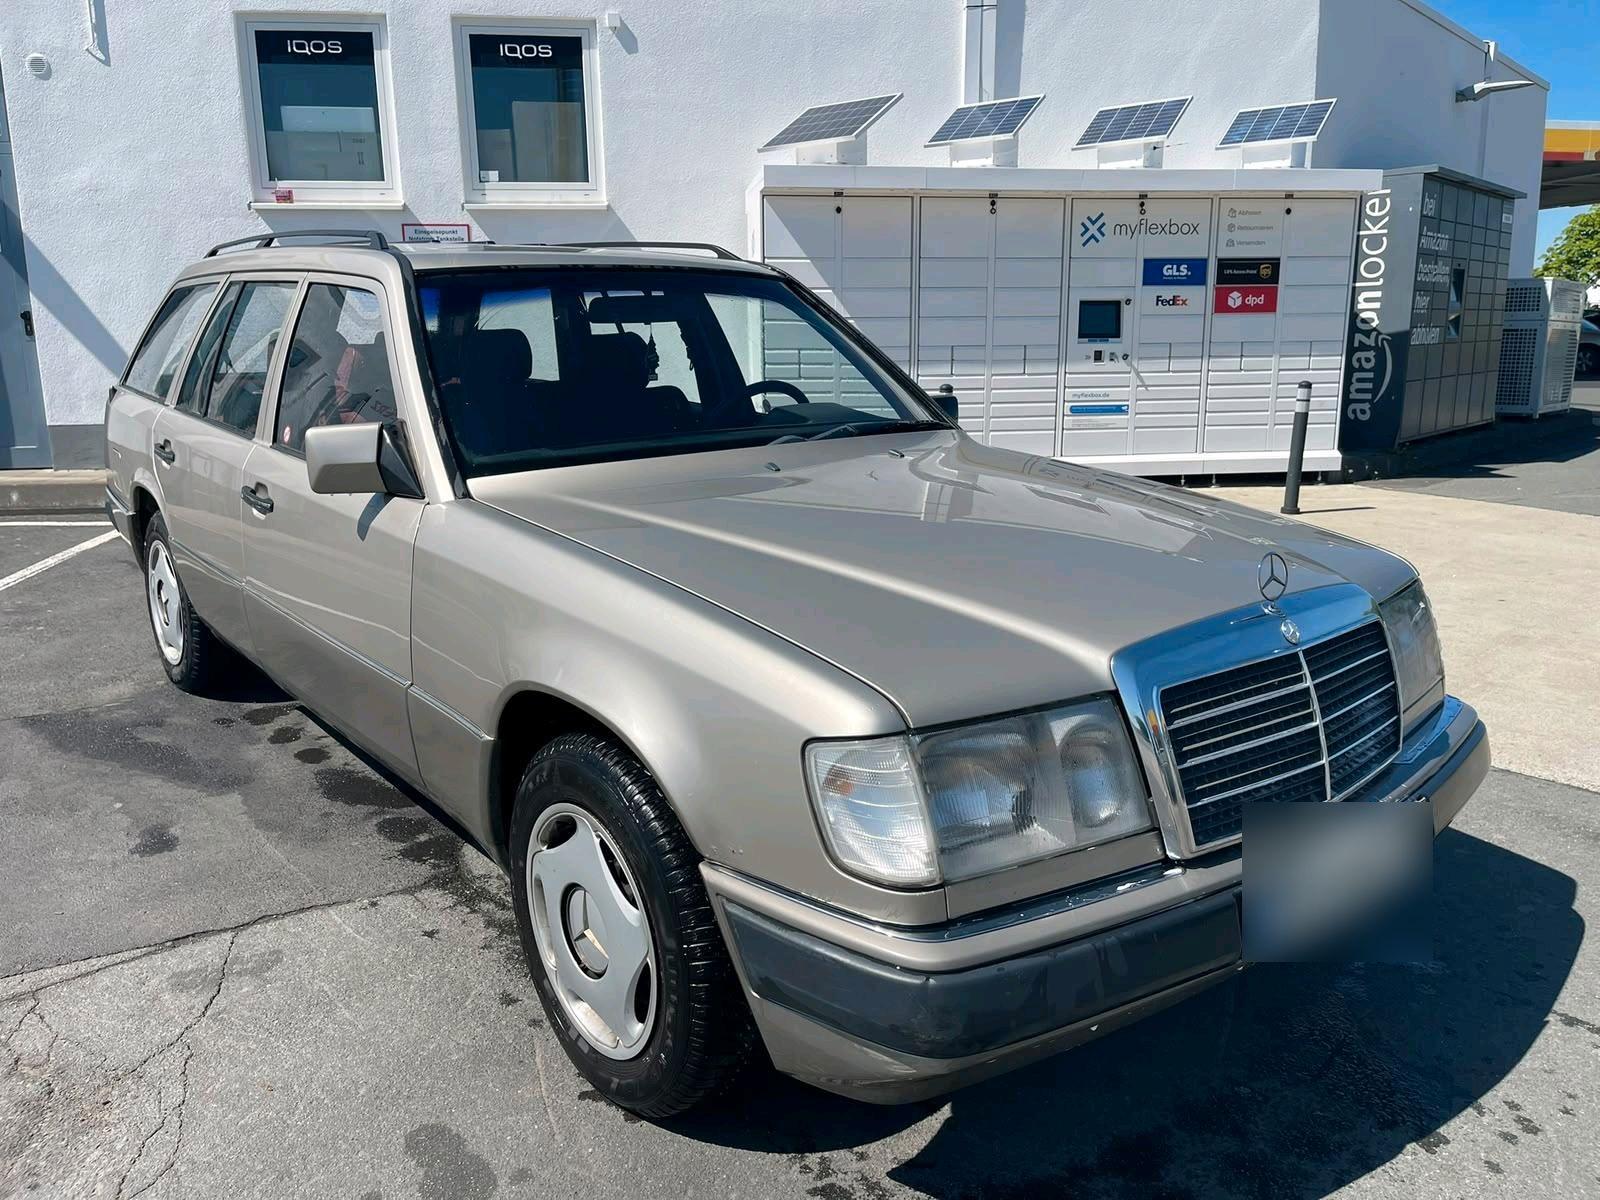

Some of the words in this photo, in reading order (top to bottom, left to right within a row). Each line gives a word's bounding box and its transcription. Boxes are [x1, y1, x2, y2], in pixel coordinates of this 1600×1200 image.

[287, 39, 342, 55] IQOS
[499, 43, 552, 59] IQOS
[1423, 193, 1437, 216] bei
[1113, 218, 1200, 240] myflexbox
[1419, 226, 1449, 251] Amazon
[1155, 295, 1189, 307] FedEx
[1245, 294, 1265, 306] dpd
